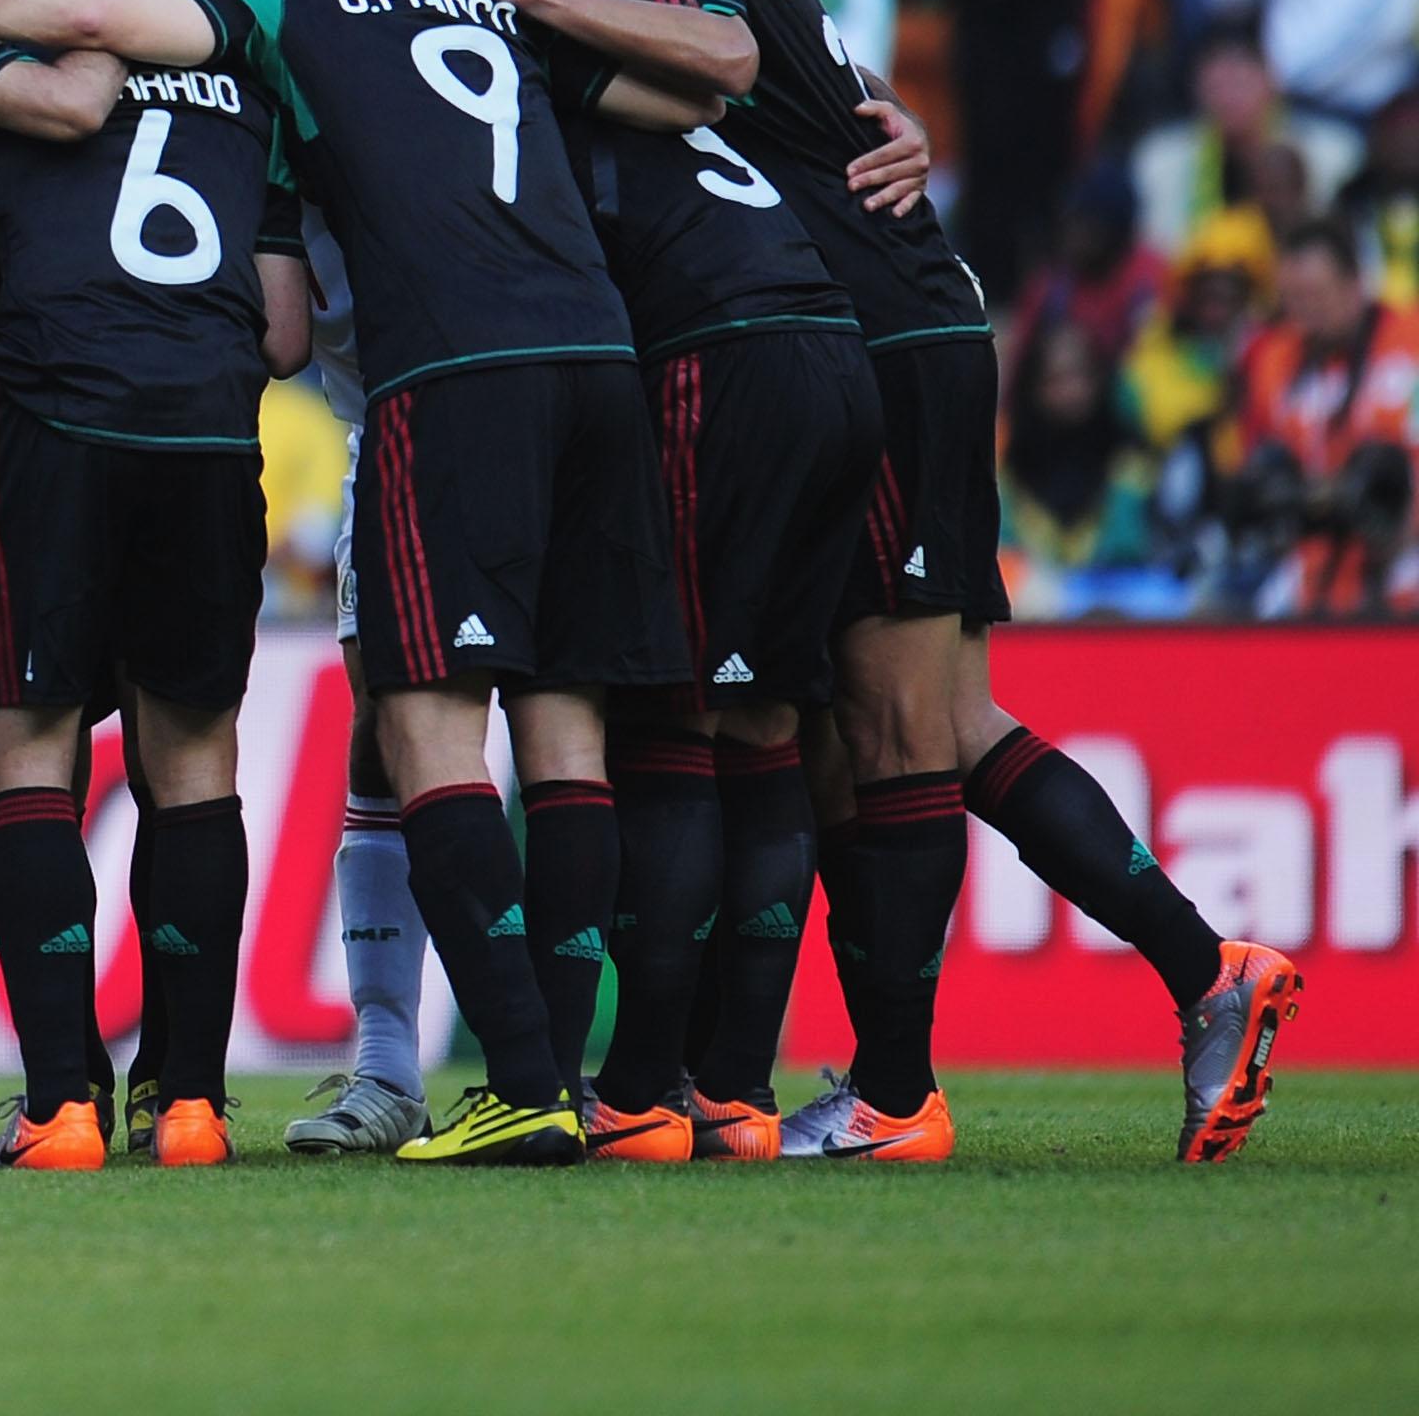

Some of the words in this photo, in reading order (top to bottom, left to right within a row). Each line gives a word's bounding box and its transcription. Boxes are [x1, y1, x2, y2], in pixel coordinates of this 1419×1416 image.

[110, 109, 223, 285] 6
[410, 24, 521, 205] 9
[454, 634, 495, 648] adidas
